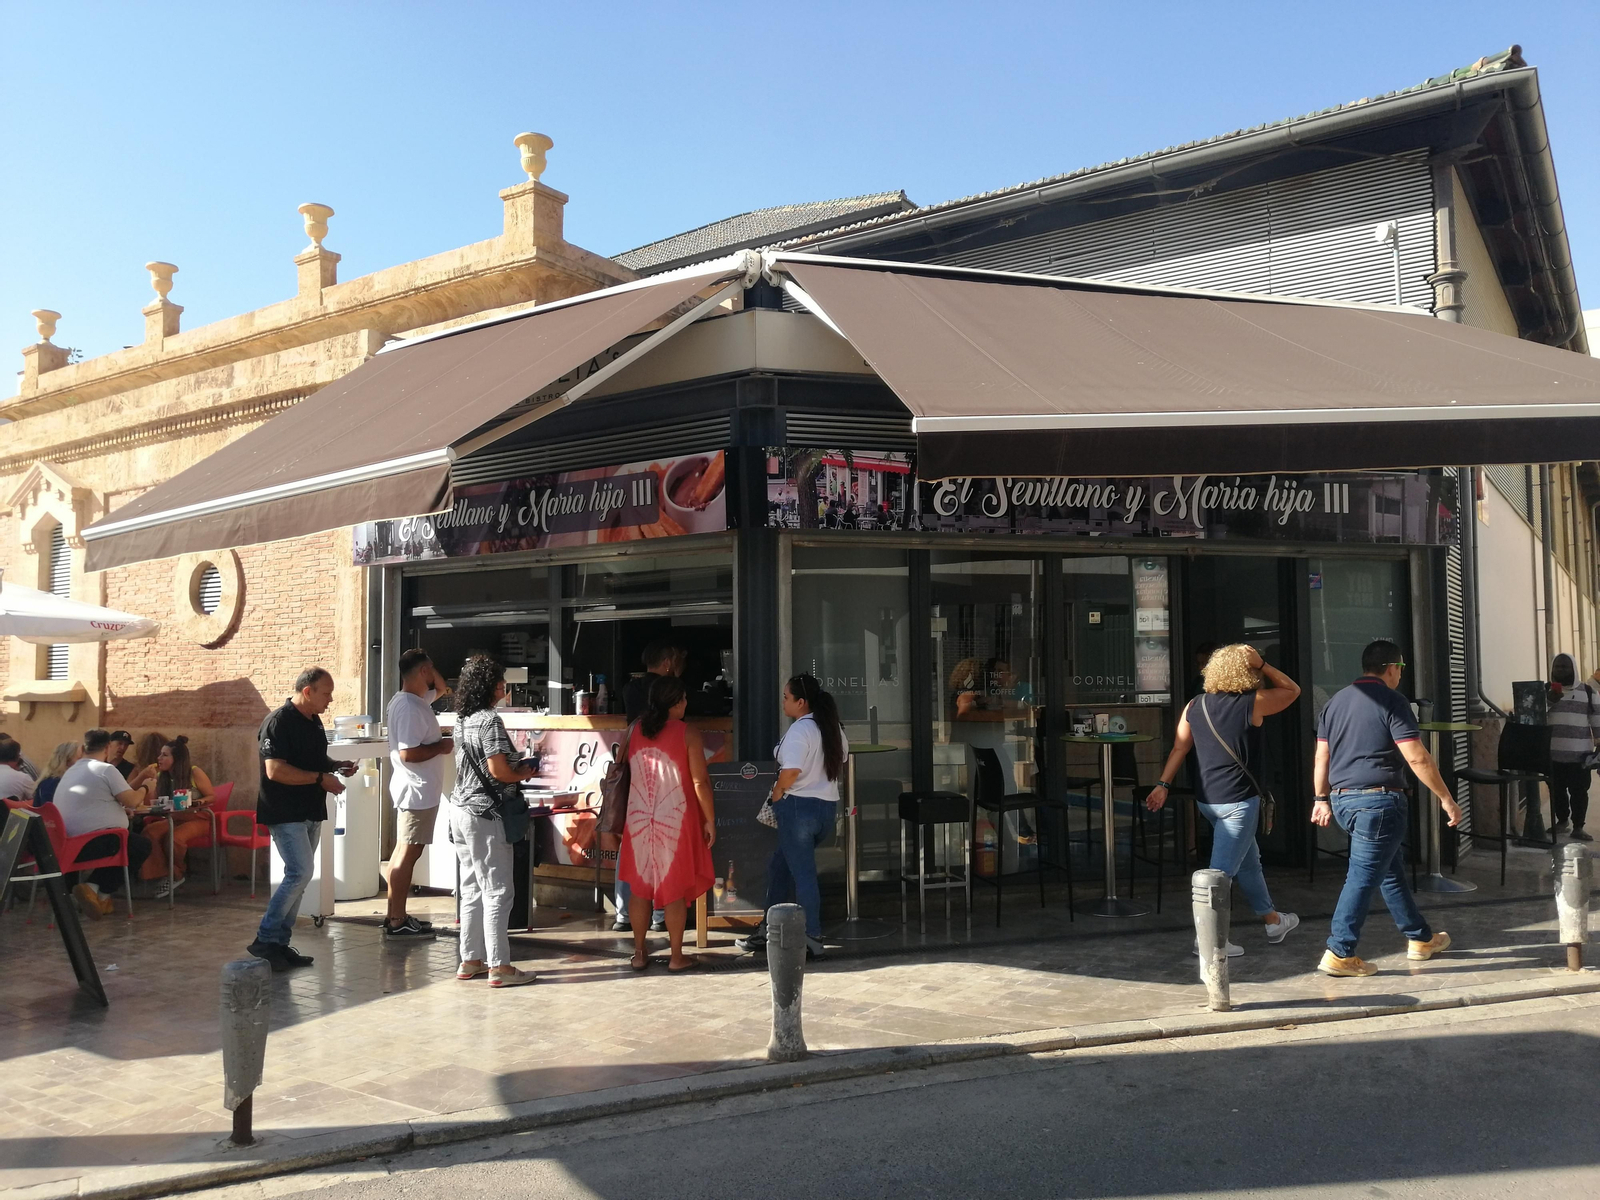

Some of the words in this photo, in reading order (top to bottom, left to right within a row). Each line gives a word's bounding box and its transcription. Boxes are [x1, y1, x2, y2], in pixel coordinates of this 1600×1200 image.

[932, 478, 974, 516] El
[982, 478, 1120, 518] Sevillano
[1123, 486, 1146, 524] y
[1264, 475, 1316, 526] hija
[1324, 482, 1349, 514] III
[399, 517, 420, 541] El
[422, 498, 496, 539] Sevillano
[497, 503, 511, 534] y
[589, 481, 626, 522] hija
[632, 478, 652, 507] III
[813, 673, 900, 687] ORNELIA'S
[990, 671, 1003, 679] THE
[1072, 675, 1135, 686] CORNEL
[990, 688, 1016, 696] COFFEE
[573, 741, 599, 775] El
